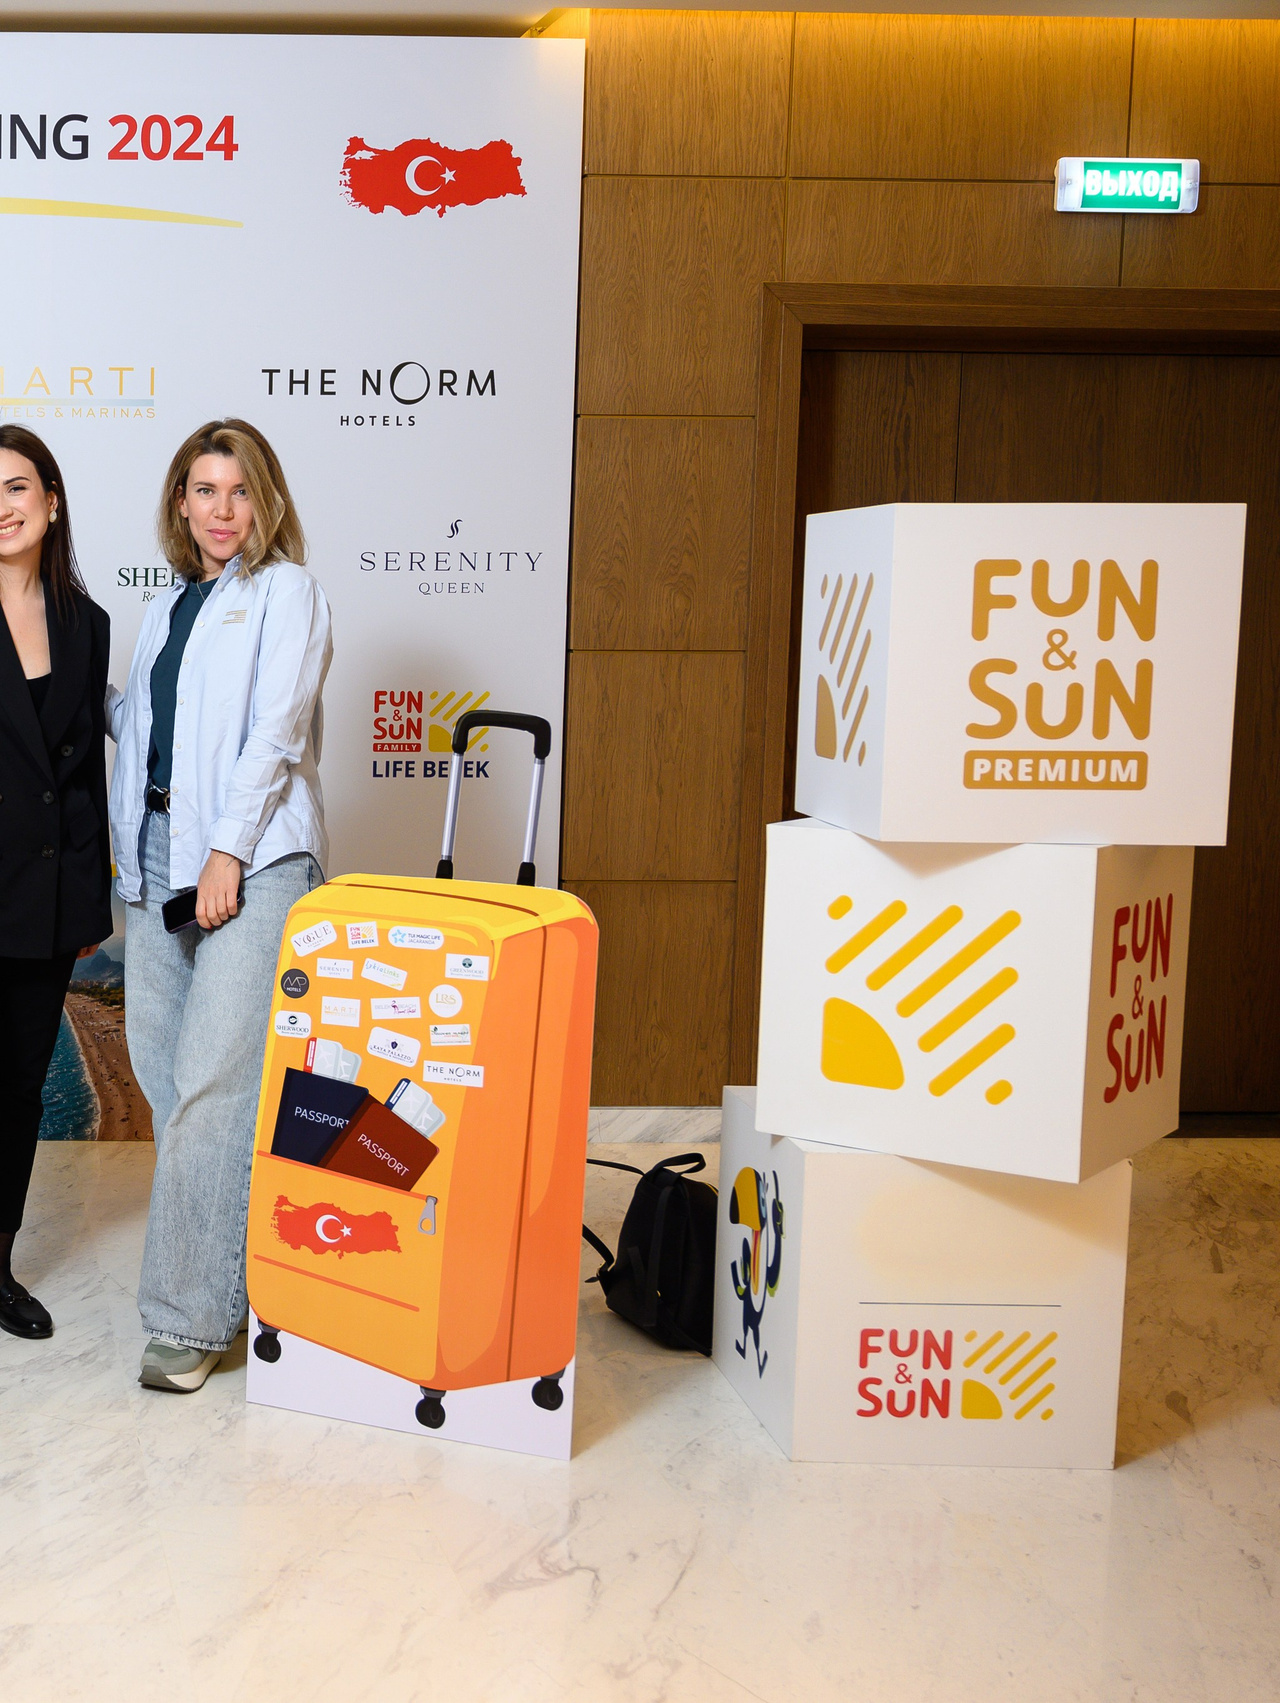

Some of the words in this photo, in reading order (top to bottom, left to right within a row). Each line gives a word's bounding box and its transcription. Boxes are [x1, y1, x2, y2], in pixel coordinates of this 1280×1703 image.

[106, 115, 239, 161] 2024
[1085, 170, 1178, 202] ВЫХОД
[262, 369, 336, 395] THE
[362, 361, 496, 405] NORM
[54, 408, 64, 418] &
[72, 408, 155, 418] MARINAS
[340, 416, 416, 426] HOTELS
[360, 552, 543, 571] SERENITY
[419, 582, 484, 595] QUEEN
[972, 559, 1159, 642] FUN
[1042, 629, 1077, 671] &
[374, 691, 423, 713] FUN
[393, 710, 402, 721] &
[373, 761, 415, 777] LIFE
[424, 761, 490, 778] BEEK
[973, 758, 1137, 782] PREMIUM
[1110, 893, 1173, 998] FUN
[1132, 975, 1144, 1019] &
[449, 1067, 480, 1077] NORM
[358, 1134, 409, 1176] PASSPORT
[859, 1328, 953, 1370] FUN
[894, 1363, 912, 1384] &
